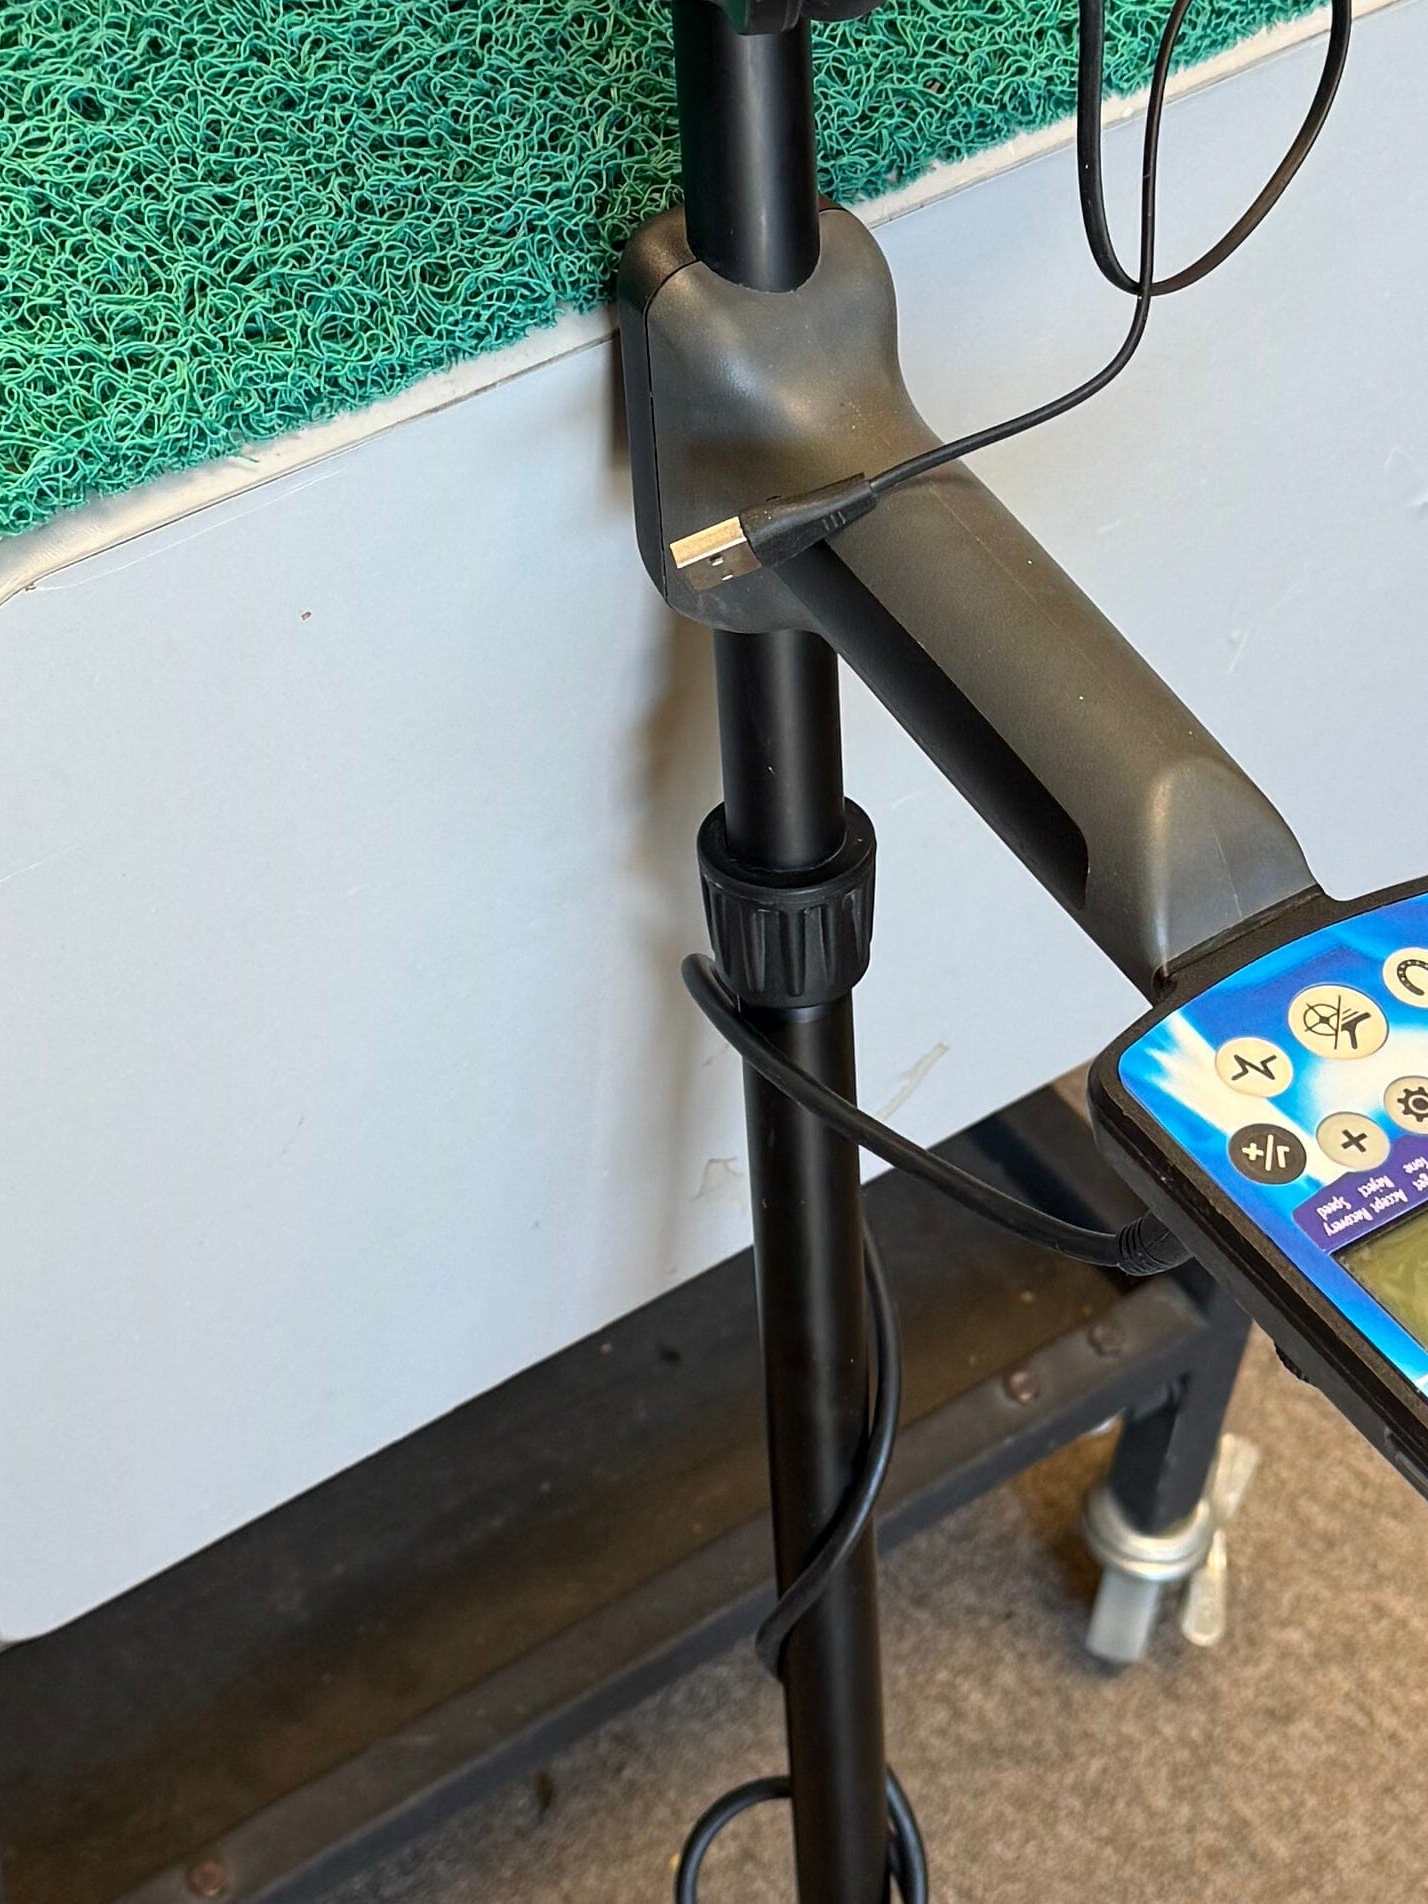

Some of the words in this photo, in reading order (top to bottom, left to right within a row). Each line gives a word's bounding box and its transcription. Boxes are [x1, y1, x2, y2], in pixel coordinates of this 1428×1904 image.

[1357, 1174, 1395, 1199] Reject
[1316, 1195, 1353, 1221] Speed
[1370, 1187, 1409, 1218] Accept
[1323, 1207, 1375, 1238] Recovery
